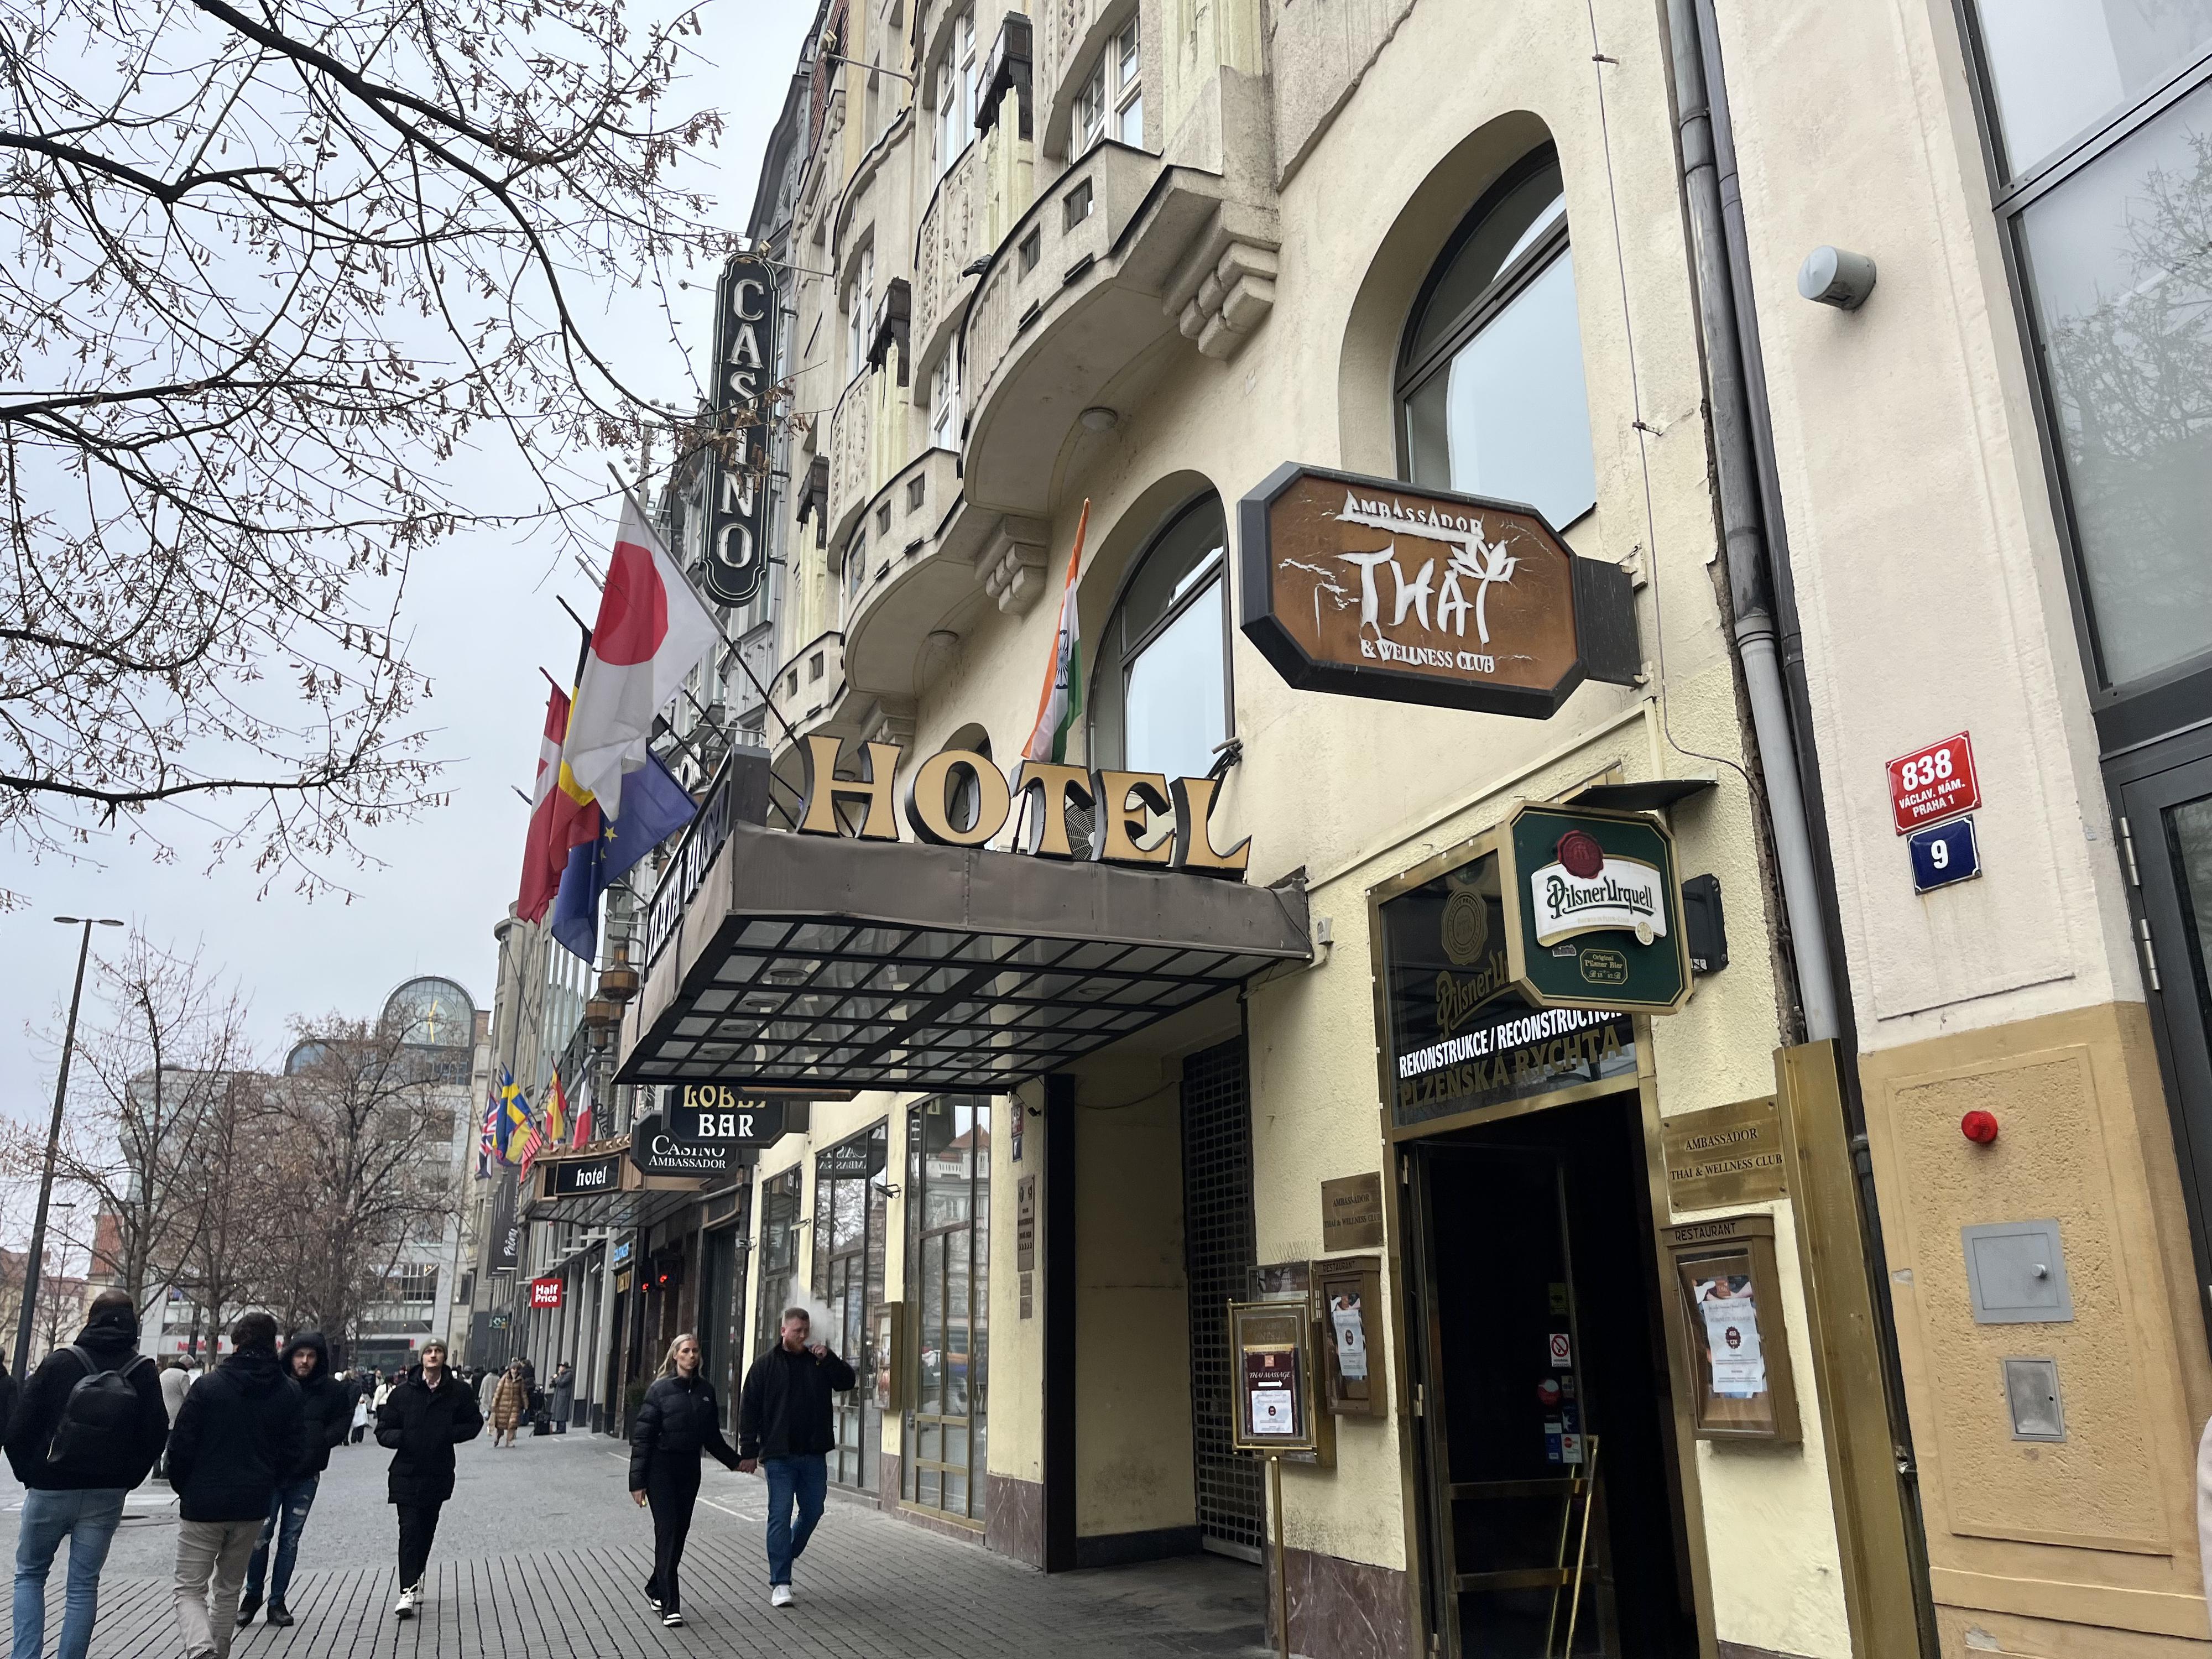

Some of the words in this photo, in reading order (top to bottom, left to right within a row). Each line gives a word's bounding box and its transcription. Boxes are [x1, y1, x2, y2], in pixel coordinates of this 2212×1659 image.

[717, 279, 765, 568] CASINO
[1343, 490, 1485, 540] AMBASSADOR
[1333, 539, 1491, 644] THAI
[1361, 639, 1377, 658] &
[1375, 637, 1453, 669] WELLNESS
[1457, 650, 1495, 674] CLUB
[1902, 749, 1953, 791] 838
[1899, 787, 1936, 809] VÁCLAV.
[1938, 778, 1965, 795] NÁM.
[799, 734, 1251, 878] HOTEL
[1912, 798, 1947, 817] PRAHA
[1948, 795, 1955, 805] 1
[1931, 839, 1949, 869] 9
[647, 849, 684, 968] ZLATÁ
[685, 783, 726, 905] HUSA
[1547, 875, 1606, 920] Pilsner
[1603, 876, 1653, 915] Urquell
[1584, 959, 1608, 968] Pilsner
[1436, 968, 1491, 1041] Pilsner
[1399, 1029, 1489, 1078] REKONSTRUKCE
[1490, 1027, 1495, 1052] /
[1497, 1009, 1622, 1050] RECONSTRUCT
[1400, 1050, 1510, 1110] PLZEŇSKÁ
[1514, 1025, 1624, 1079] RYCHTA
[684, 1085, 766, 1108] LOB
[698, 1114, 754, 1137] BAR
[1686, 1128, 1757, 1151] AMBASSADOR
[649, 1155, 726, 1168] AMBASSADOR
[1670, 1167, 1693, 1180] THAI
[1695, 1167, 1703, 1176] &
[1705, 1159, 1753, 1175] WELLNESS
[1756, 1154, 1782, 1167] CLUB
[576, 1165, 607, 1187] hotel
[1333, 1193, 1370, 1207] AMBASSADOR
[1324, 1219, 1336, 1228] THAI
[1342, 1215, 1367, 1225] WELLNESS
[1368, 1212, 1381, 1222] CLUB
[1675, 1222, 1736, 1241] RESTAURANT
[1323, 1260, 1355, 1272] RESTAURANT
[535, 1284, 558, 1295] Half
[535, 1294, 557, 1303] Price
[1264, 1371, 1291, 1380] MASSAGE
